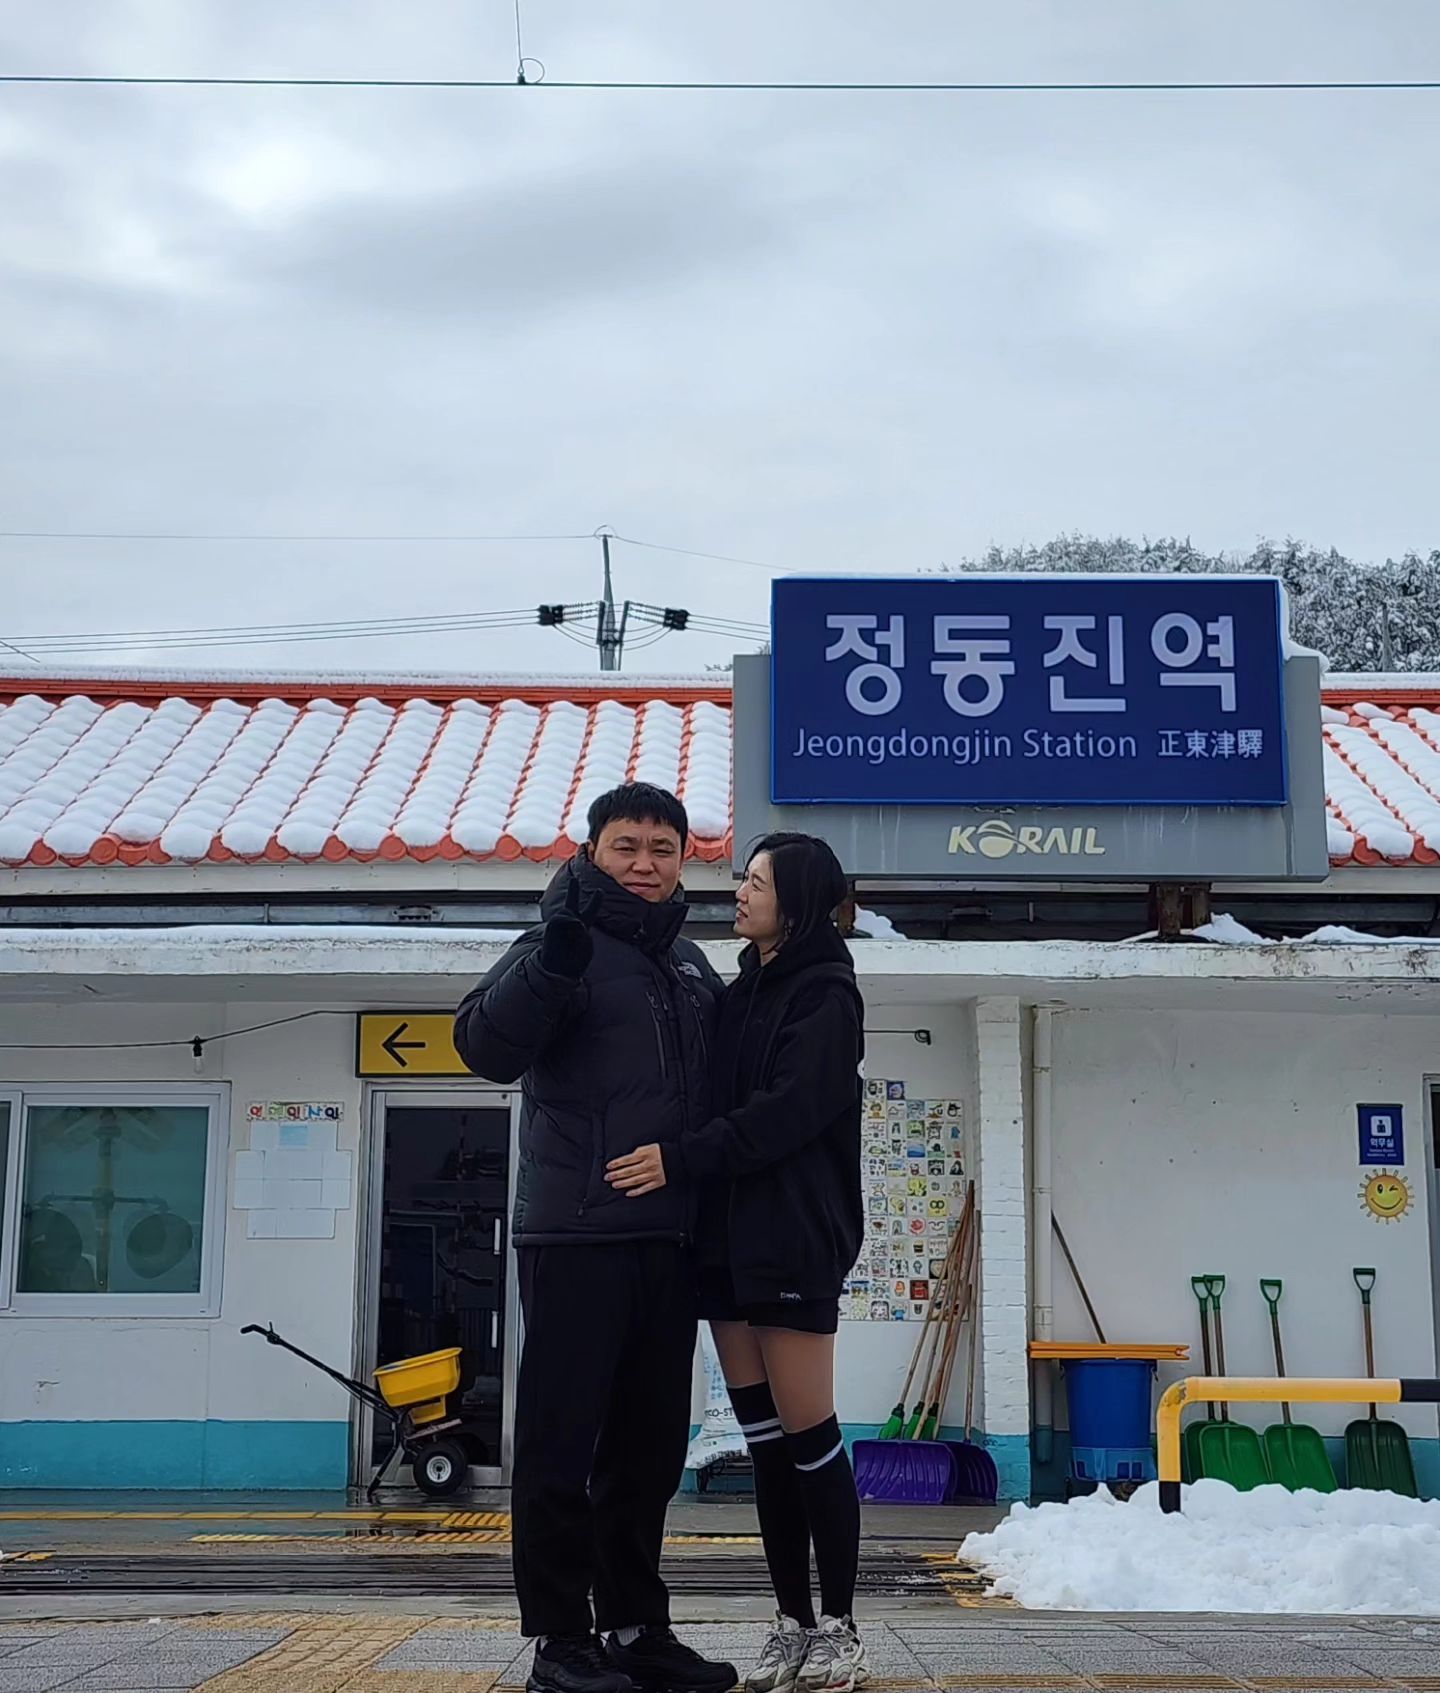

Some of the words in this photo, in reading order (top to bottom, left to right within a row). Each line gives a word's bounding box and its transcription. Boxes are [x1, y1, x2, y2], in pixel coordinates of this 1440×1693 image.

[825, 612, 1237, 718] 정동진역
[793, 727, 1012, 765] Jeongdongjin
[1023, 728, 1137, 758] Station
[1158, 729, 1263, 759] 正東津驛
[948, 819, 1106, 858] KORAIL
